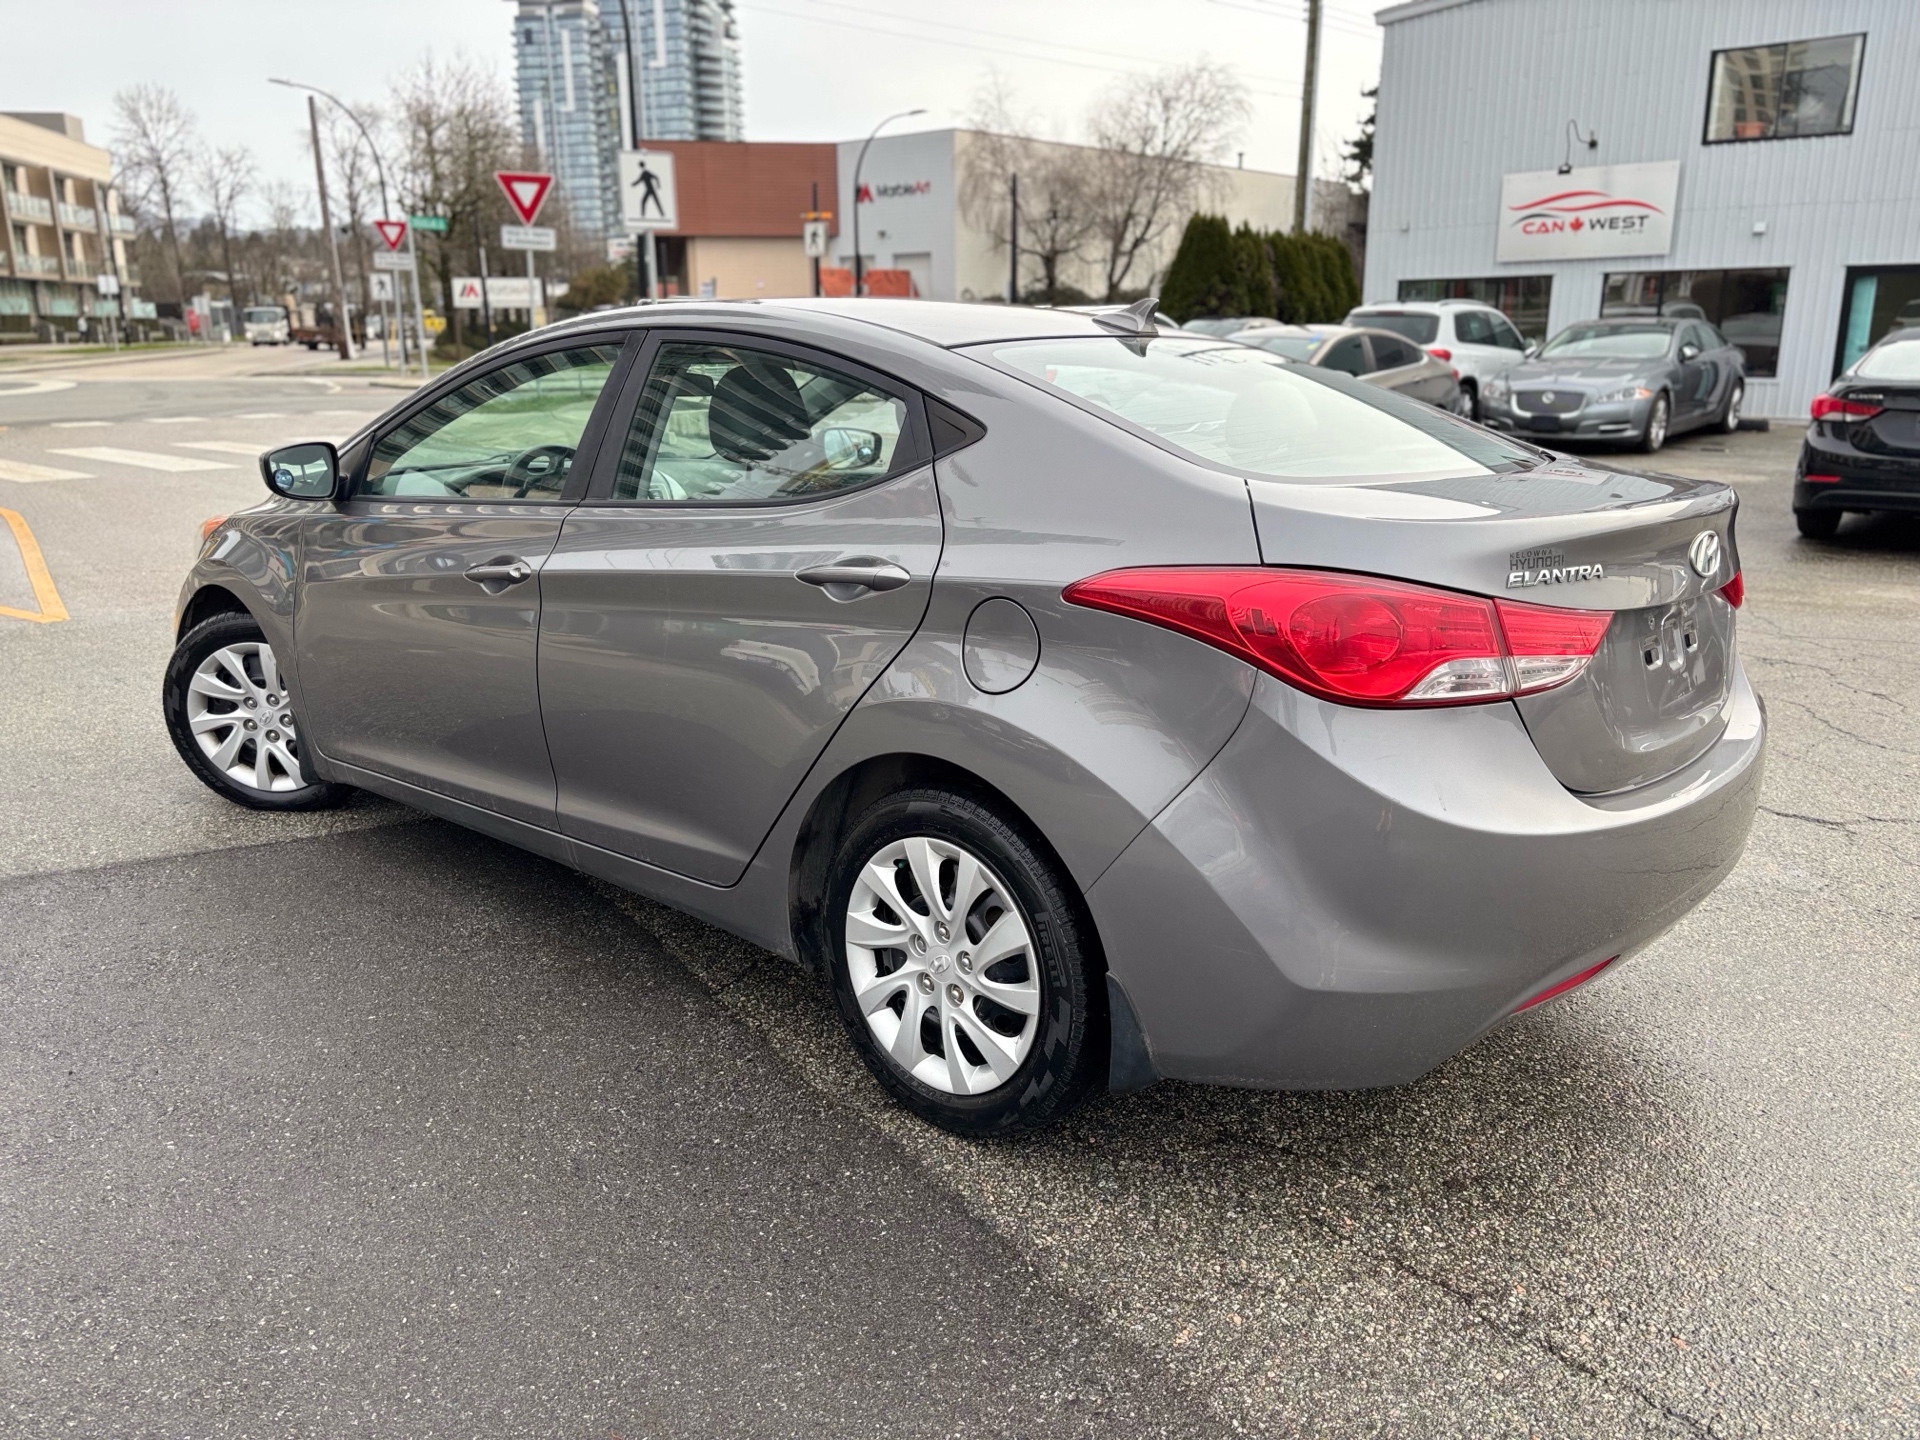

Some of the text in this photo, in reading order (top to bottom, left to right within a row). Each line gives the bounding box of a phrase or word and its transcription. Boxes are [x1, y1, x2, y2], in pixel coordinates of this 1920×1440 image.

[1522, 215, 1649, 235] CAN WEST
[1509, 549, 1552, 559] KELOWNA
[1509, 555, 1564, 571] HYUNDAI
[1506, 563, 1604, 589] ELANTRA
[1034, 911, 1067, 988] PIRELLI
